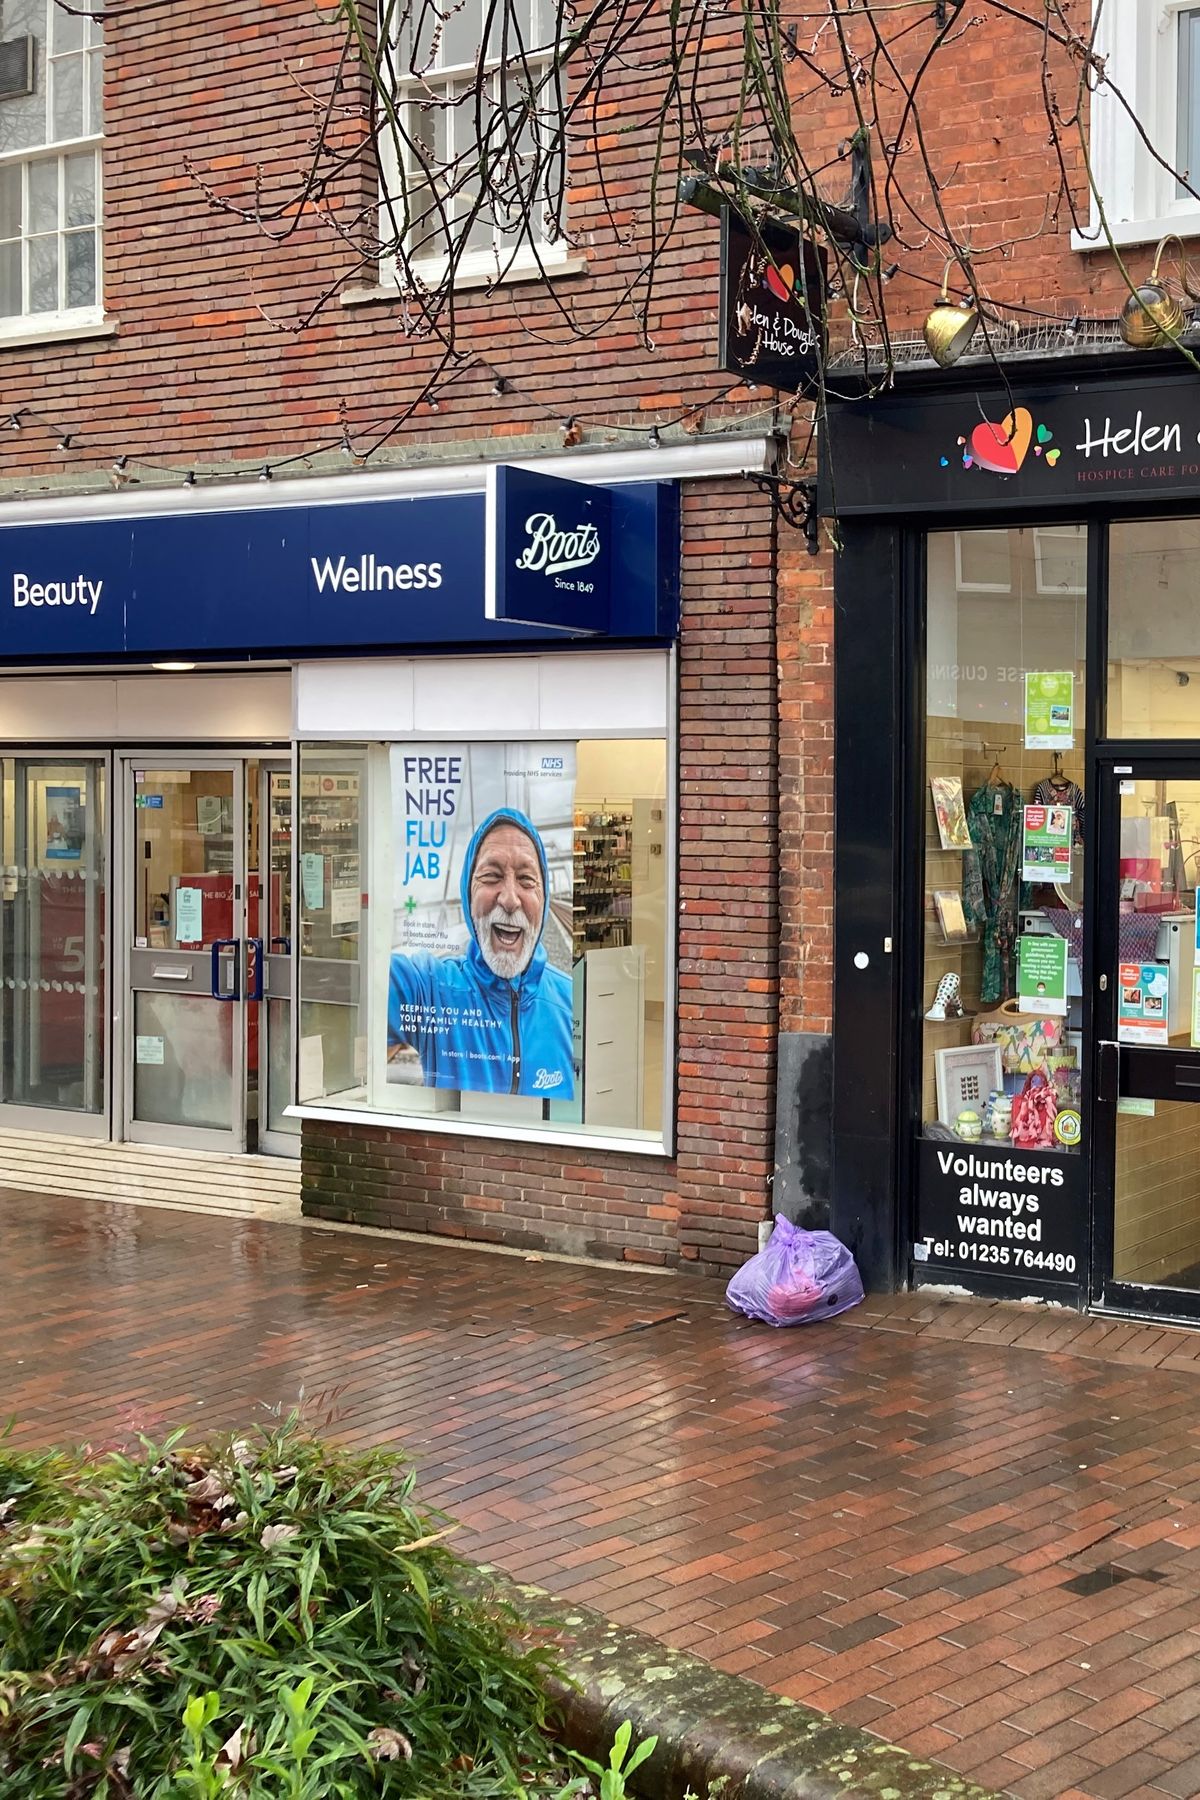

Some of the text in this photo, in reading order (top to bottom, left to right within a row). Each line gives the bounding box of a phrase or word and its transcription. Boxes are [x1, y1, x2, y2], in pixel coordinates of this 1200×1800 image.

[773, 312, 781, 337] &
[762, 331, 795, 356] House
[1076, 410, 1181, 458] Helen
[1077, 469, 1134, 482] HOSPICE
[1141, 466, 1175, 478] CARE
[515, 512, 600, 576] Boots
[311, 554, 442, 593] Wellness
[554, 577, 594, 593] Since 1849
[13, 573, 103, 615] Beauty
[403, 757, 461, 783] FREE
[542, 758, 563, 769] NHS
[405, 789, 455, 816] NHS
[406, 820, 446, 847] FLU
[403, 852, 440, 885] JAB
[214, 890, 227, 899] BIG
[408, 940, 434, 949] download
[447, 943, 460, 951] app
[409, 931, 449, 939] boots.com/flu
[400, 1004, 482, 1017] KEEPING YOU AND
[400, 1014, 502, 1028] YOUR FAMILY HEALTHY
[399, 1024, 450, 1035] AND HAPPY
[469, 1052, 500, 1061] boots.com
[506, 1055, 520, 1065] App
[532, 1068, 564, 1090] Boots
[937, 1151, 1064, 1186] Volunteers
[959, 1183, 1040, 1216] always
[957, 1215, 1042, 1242] wanted
[923, 1237, 1077, 1273] Tel: 01235 764490
